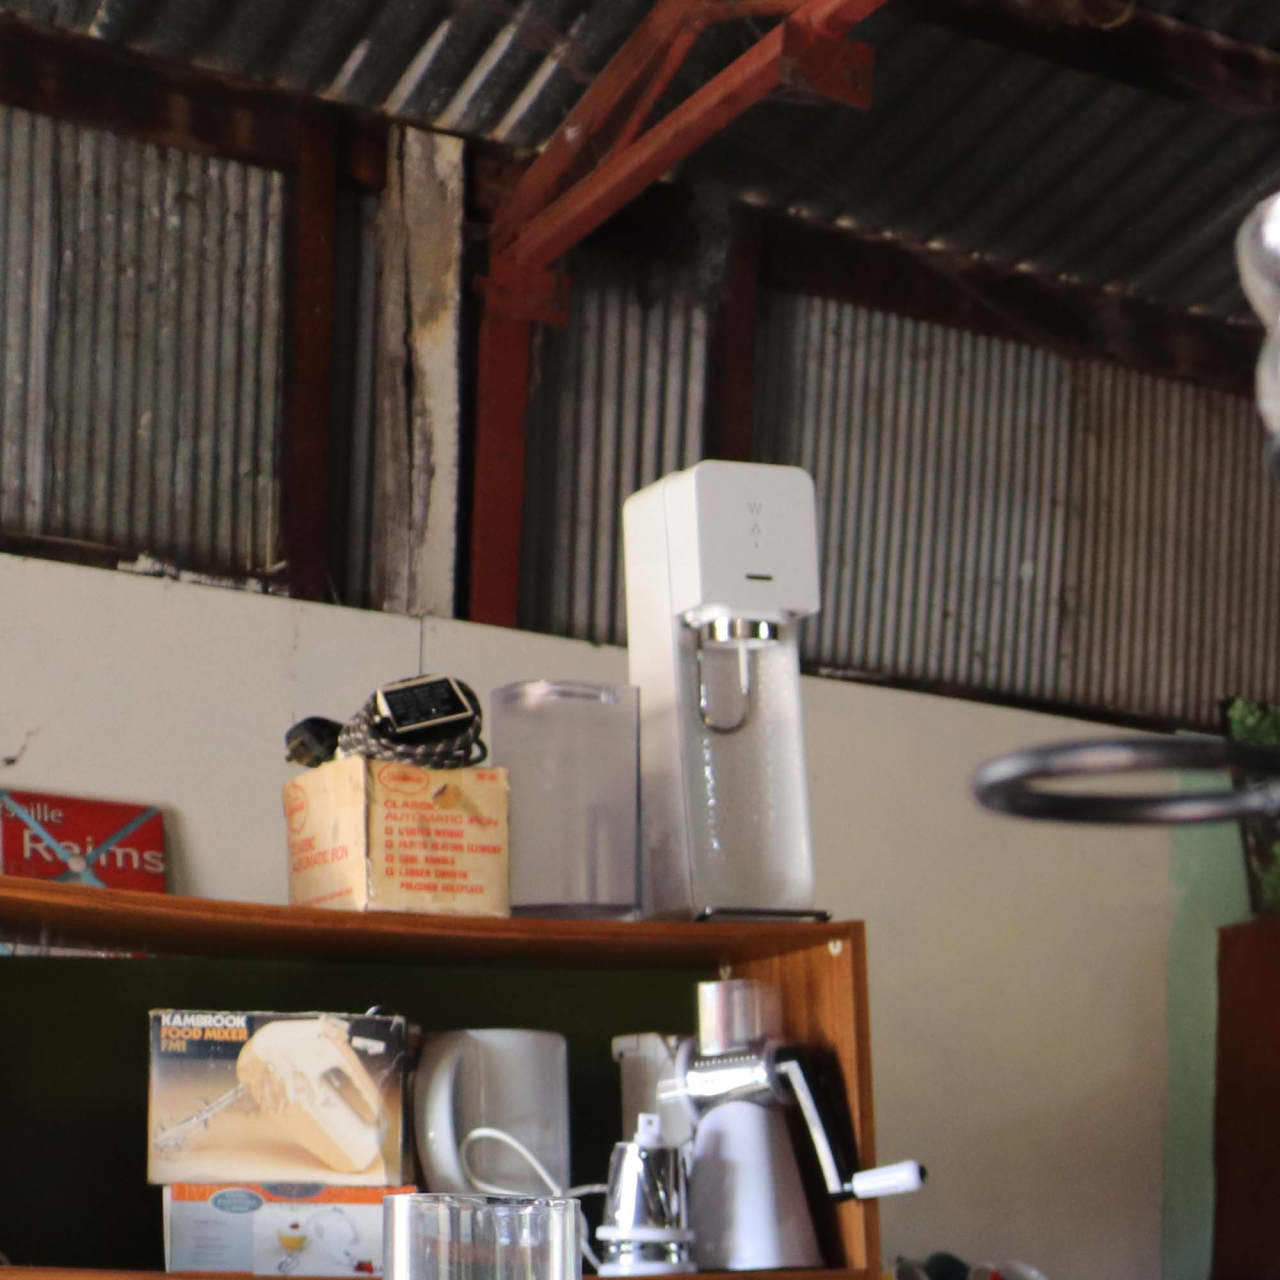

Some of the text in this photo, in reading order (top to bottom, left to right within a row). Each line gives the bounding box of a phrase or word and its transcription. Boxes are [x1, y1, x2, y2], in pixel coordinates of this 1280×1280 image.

[161, 1014, 247, 1028] KAMBROOK
[160, 1027, 248, 1042] FOOD MIXER
